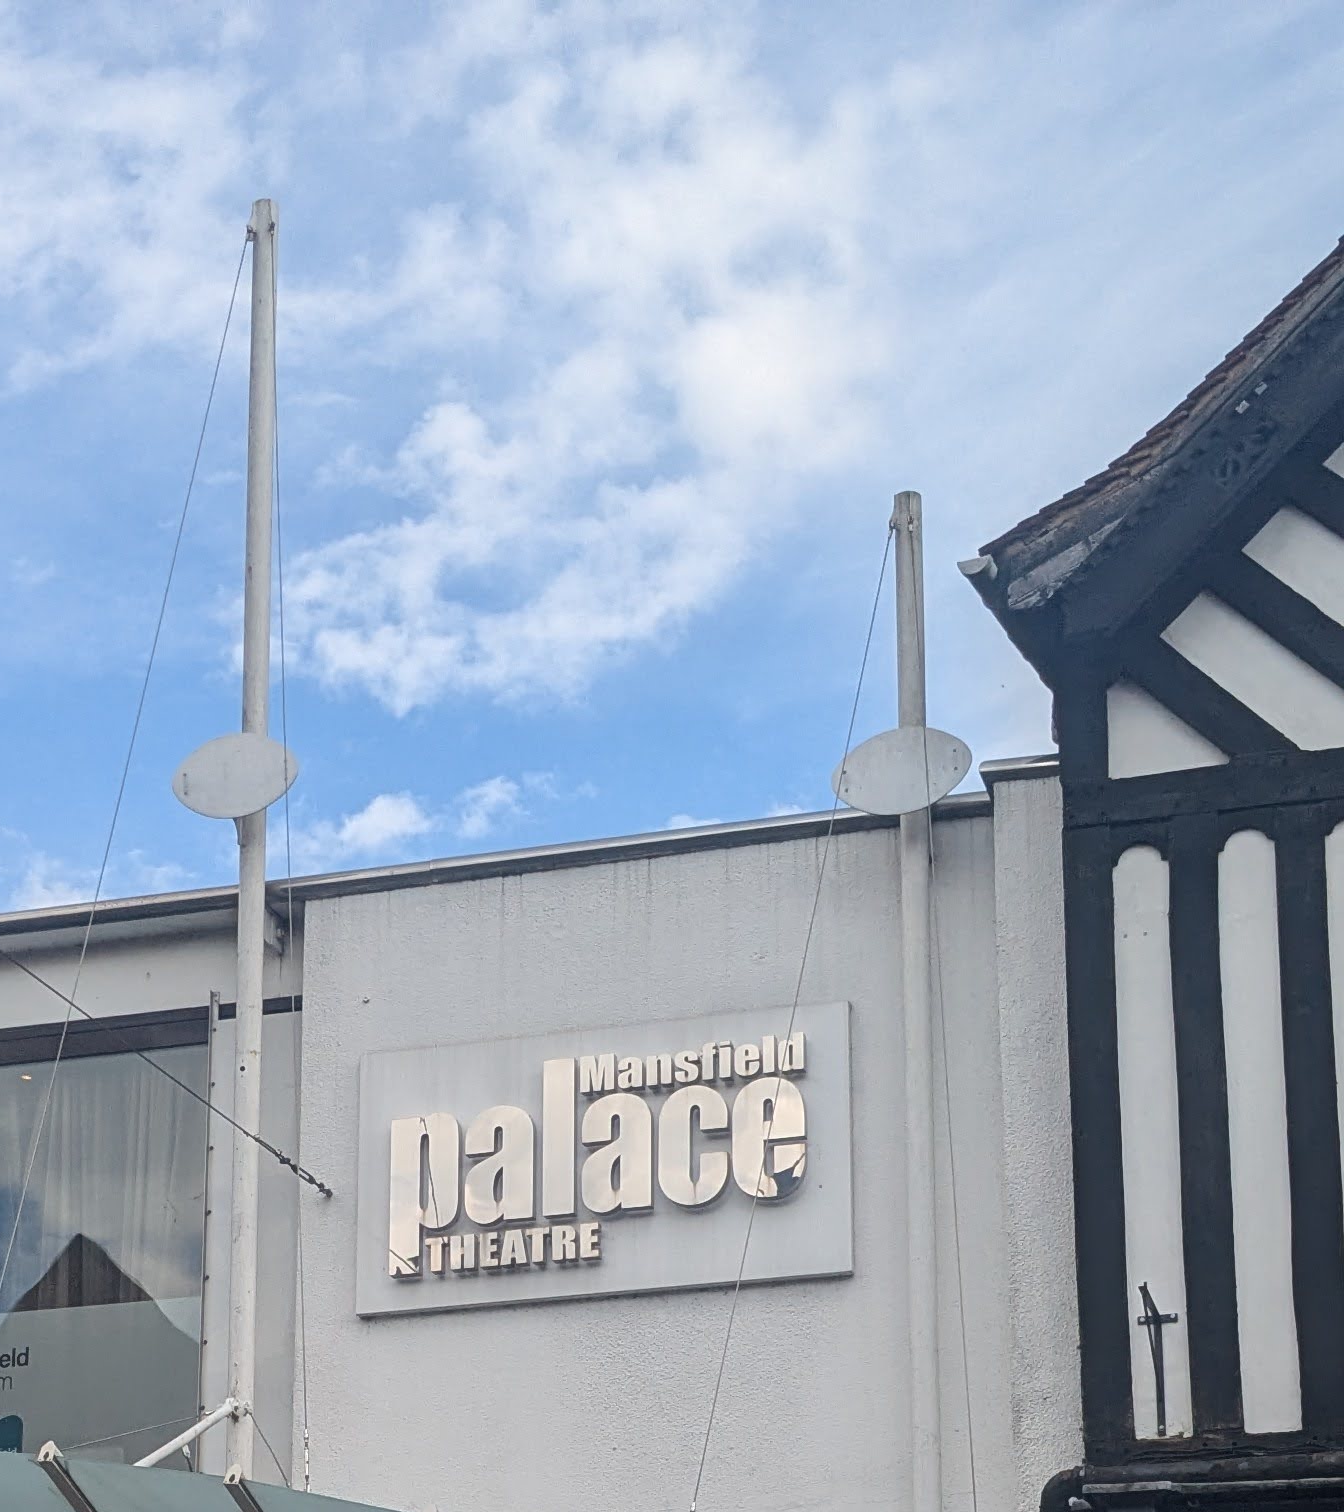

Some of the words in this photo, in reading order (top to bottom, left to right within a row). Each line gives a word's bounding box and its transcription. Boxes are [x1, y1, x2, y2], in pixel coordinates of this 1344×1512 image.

[579, 1032, 806, 1094] Mansfield
[388, 1058, 807, 1278] palace
[424, 1222, 602, 1273] THEATRE
